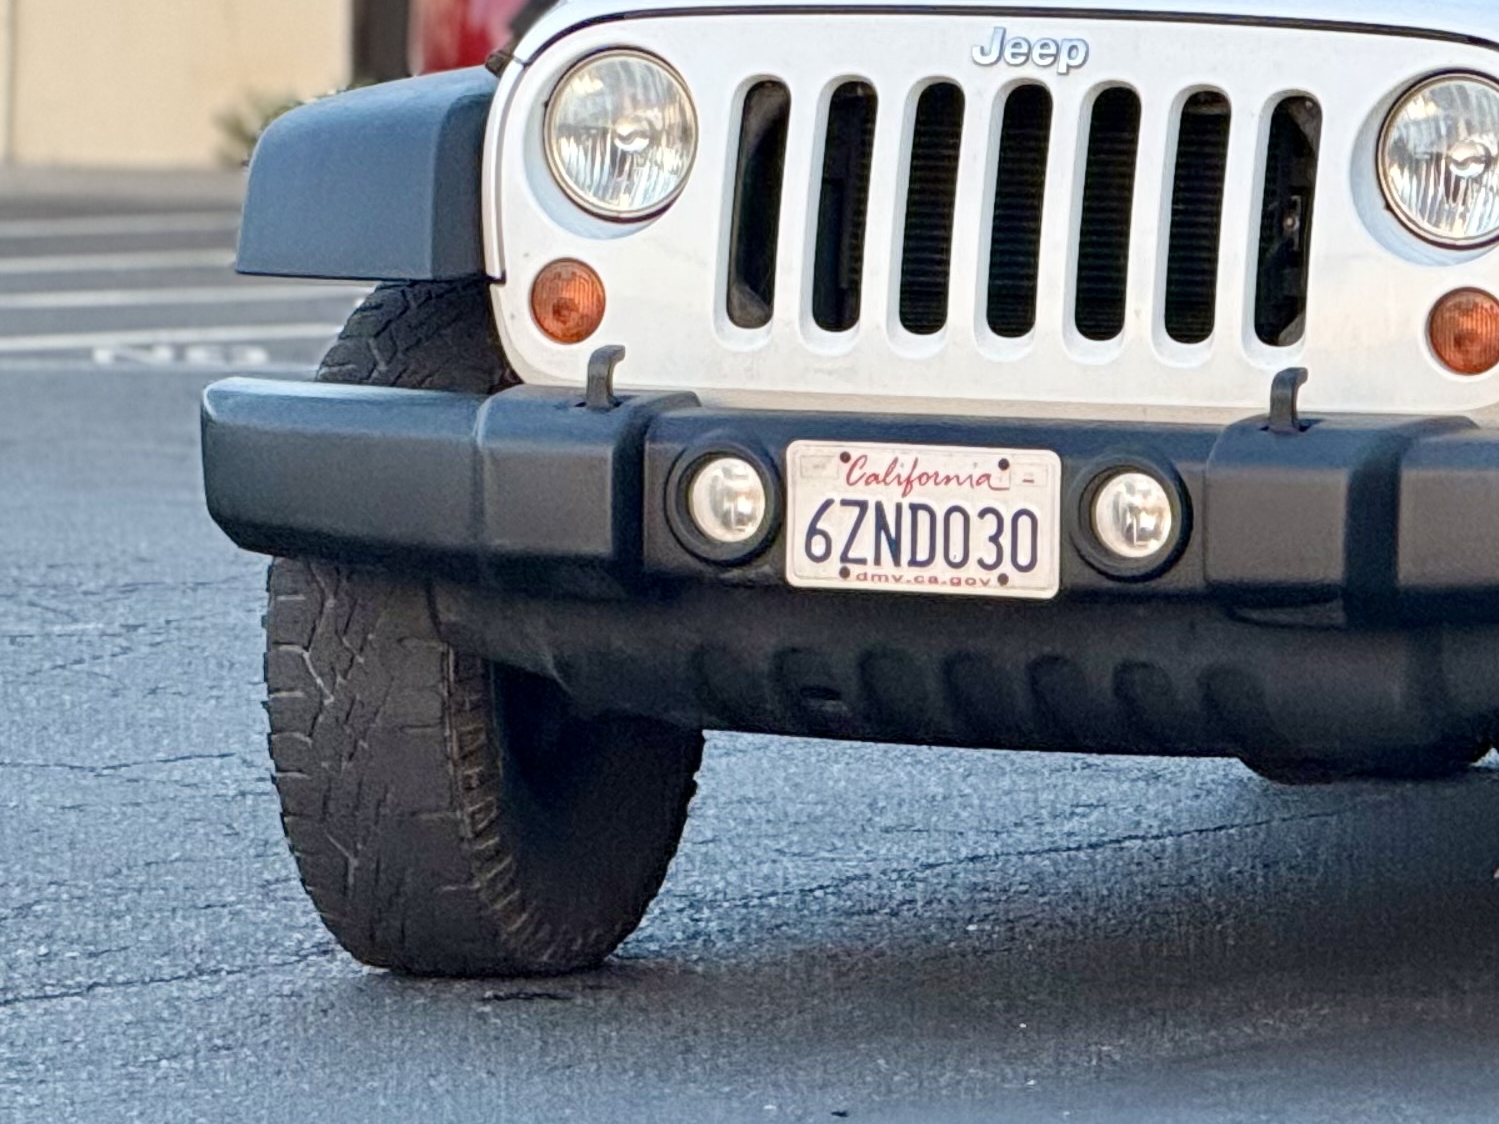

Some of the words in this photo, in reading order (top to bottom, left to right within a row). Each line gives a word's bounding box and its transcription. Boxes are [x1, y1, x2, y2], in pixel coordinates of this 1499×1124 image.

[971, 26, 1089, 76] Jeep
[845, 454, 1010, 498] California
[804, 498, 1039, 573] 6ZND030
[855, 571, 991, 588] dmv.ca.gov
